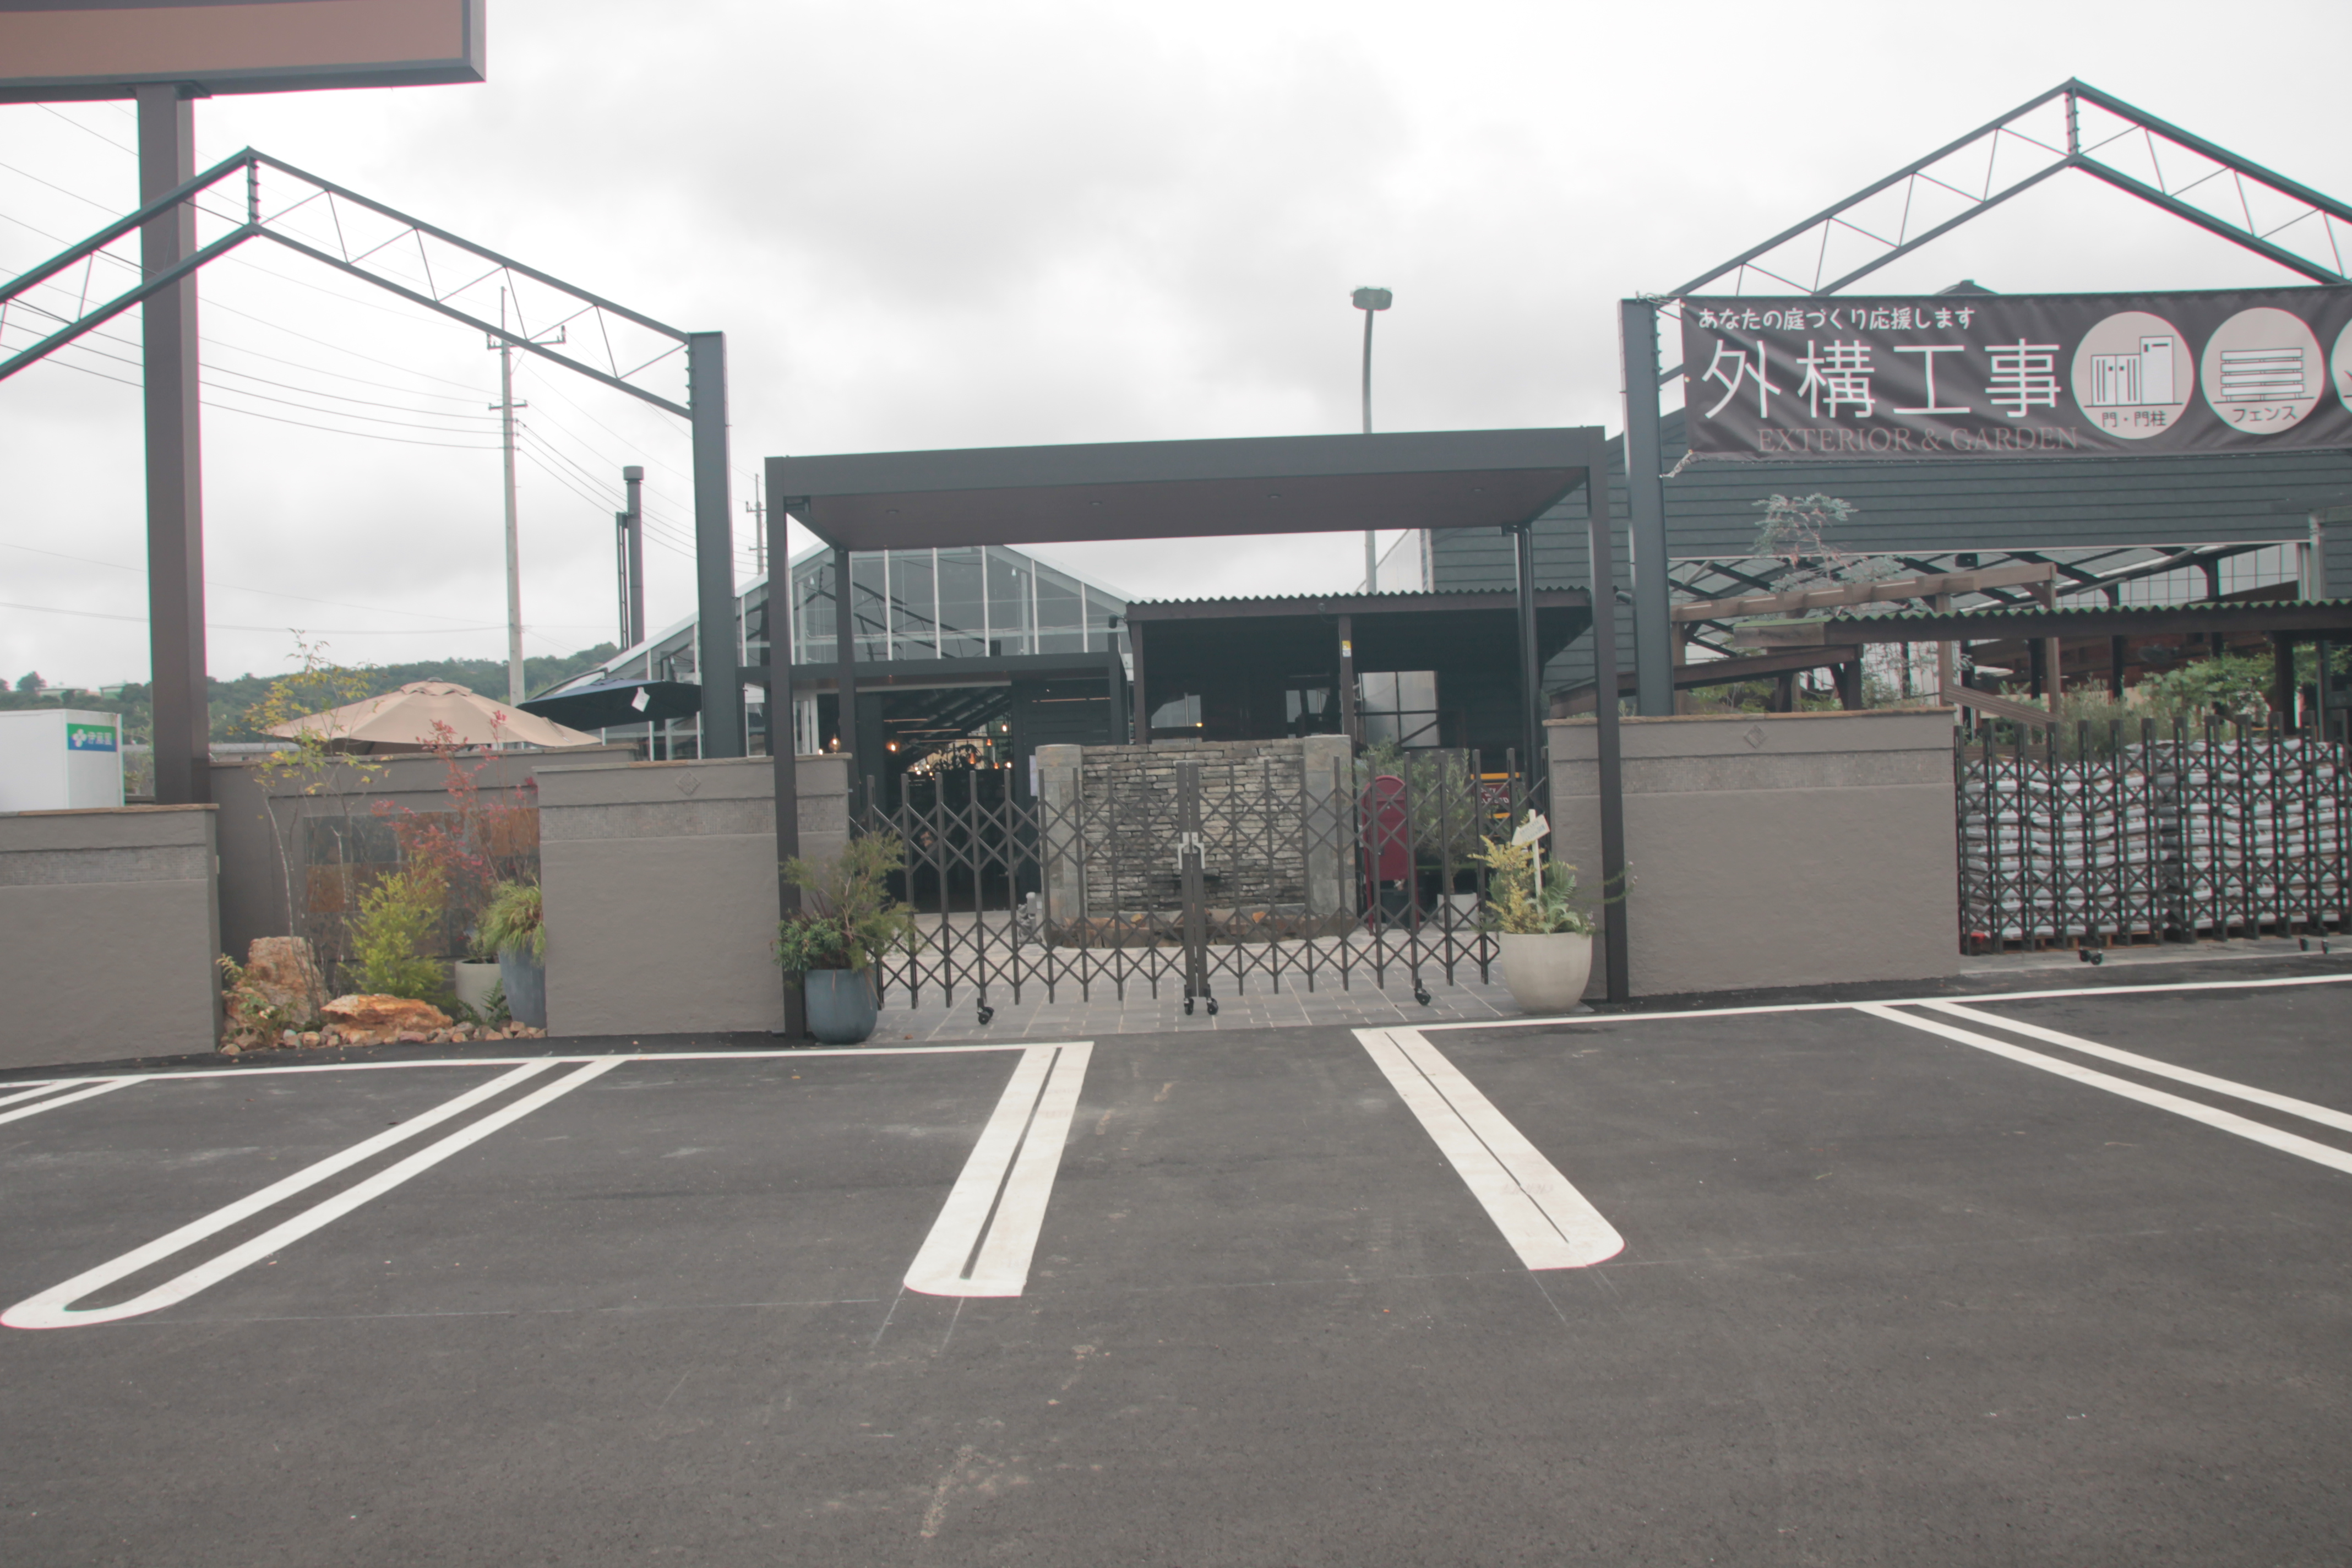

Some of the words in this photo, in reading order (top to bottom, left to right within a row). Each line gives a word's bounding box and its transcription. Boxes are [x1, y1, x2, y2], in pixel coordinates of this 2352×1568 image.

[1698, 307, 1975, 331] あなたの庭づくり応援します
[1701, 337, 2062, 419] 外構工事
[2101, 410, 2167, 428] 門・門柱
[2233, 406, 2297, 423] フェンス
[1757, 428, 1912, 452] EXTERIOR
[1921, 429, 1942, 451] &
[1950, 426, 2077, 450] GARDEN
